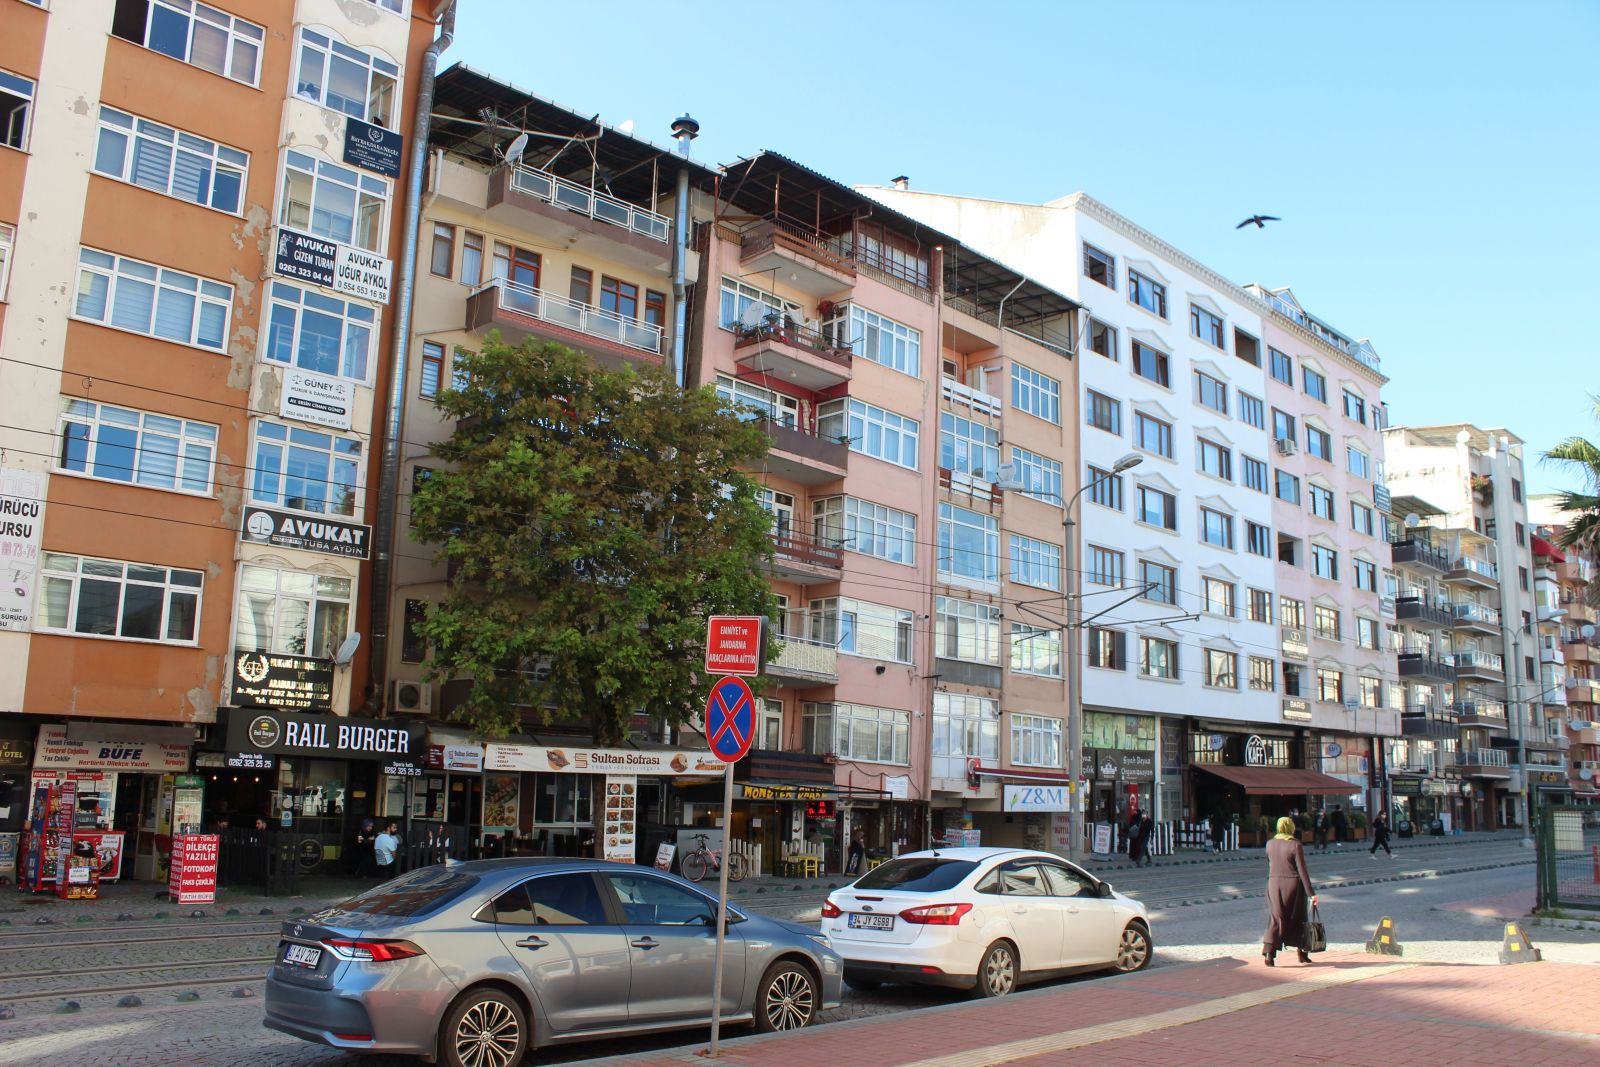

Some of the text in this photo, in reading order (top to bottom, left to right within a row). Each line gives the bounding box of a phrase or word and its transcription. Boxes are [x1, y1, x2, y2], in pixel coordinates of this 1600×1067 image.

[296, 237, 335, 256] AVUKAT
[294, 248, 334, 270] GİZEM TURAN
[348, 252, 382, 270] AVUKAT
[278, 262, 332, 283] 0262 323 04 44
[340, 264, 388, 290] UĞUR AYKOL
[344, 282, 355, 291] 554
[357, 285, 368, 295] 553
[378, 291, 386, 299] 58
[304, 378, 333, 392] GÜNEY
[314, 391, 345, 402] DANIŞMANLIK
[280, 518, 364, 545] AVUKAT
[303, 538, 330, 550] TUBA
[720, 625, 741, 635] EMNİYET
[720, 640, 746, 649] JANDARMA
[709, 653, 756, 664] ARAÇLARINA AİTTİR
[284, 721, 409, 754] RAIL BURGER
[98, 745, 143, 760] BÜFE
[592, 753, 660, 765] Sultan Sofrası
[1248, 747, 1263, 764] KAFF
[1123, 756, 1151, 765] Siyah Beyaz
[1121, 768, 1153, 776] Organizasyon
[1022, 788, 1062, 804] Z&M
[186, 842, 216, 852] DİLEKÇE
[184, 864, 215, 872] FOTOKOPİ
[853, 915, 860, 924] 34
[863, 916, 871, 925] JY
[304, 950, 318, 963] 207
